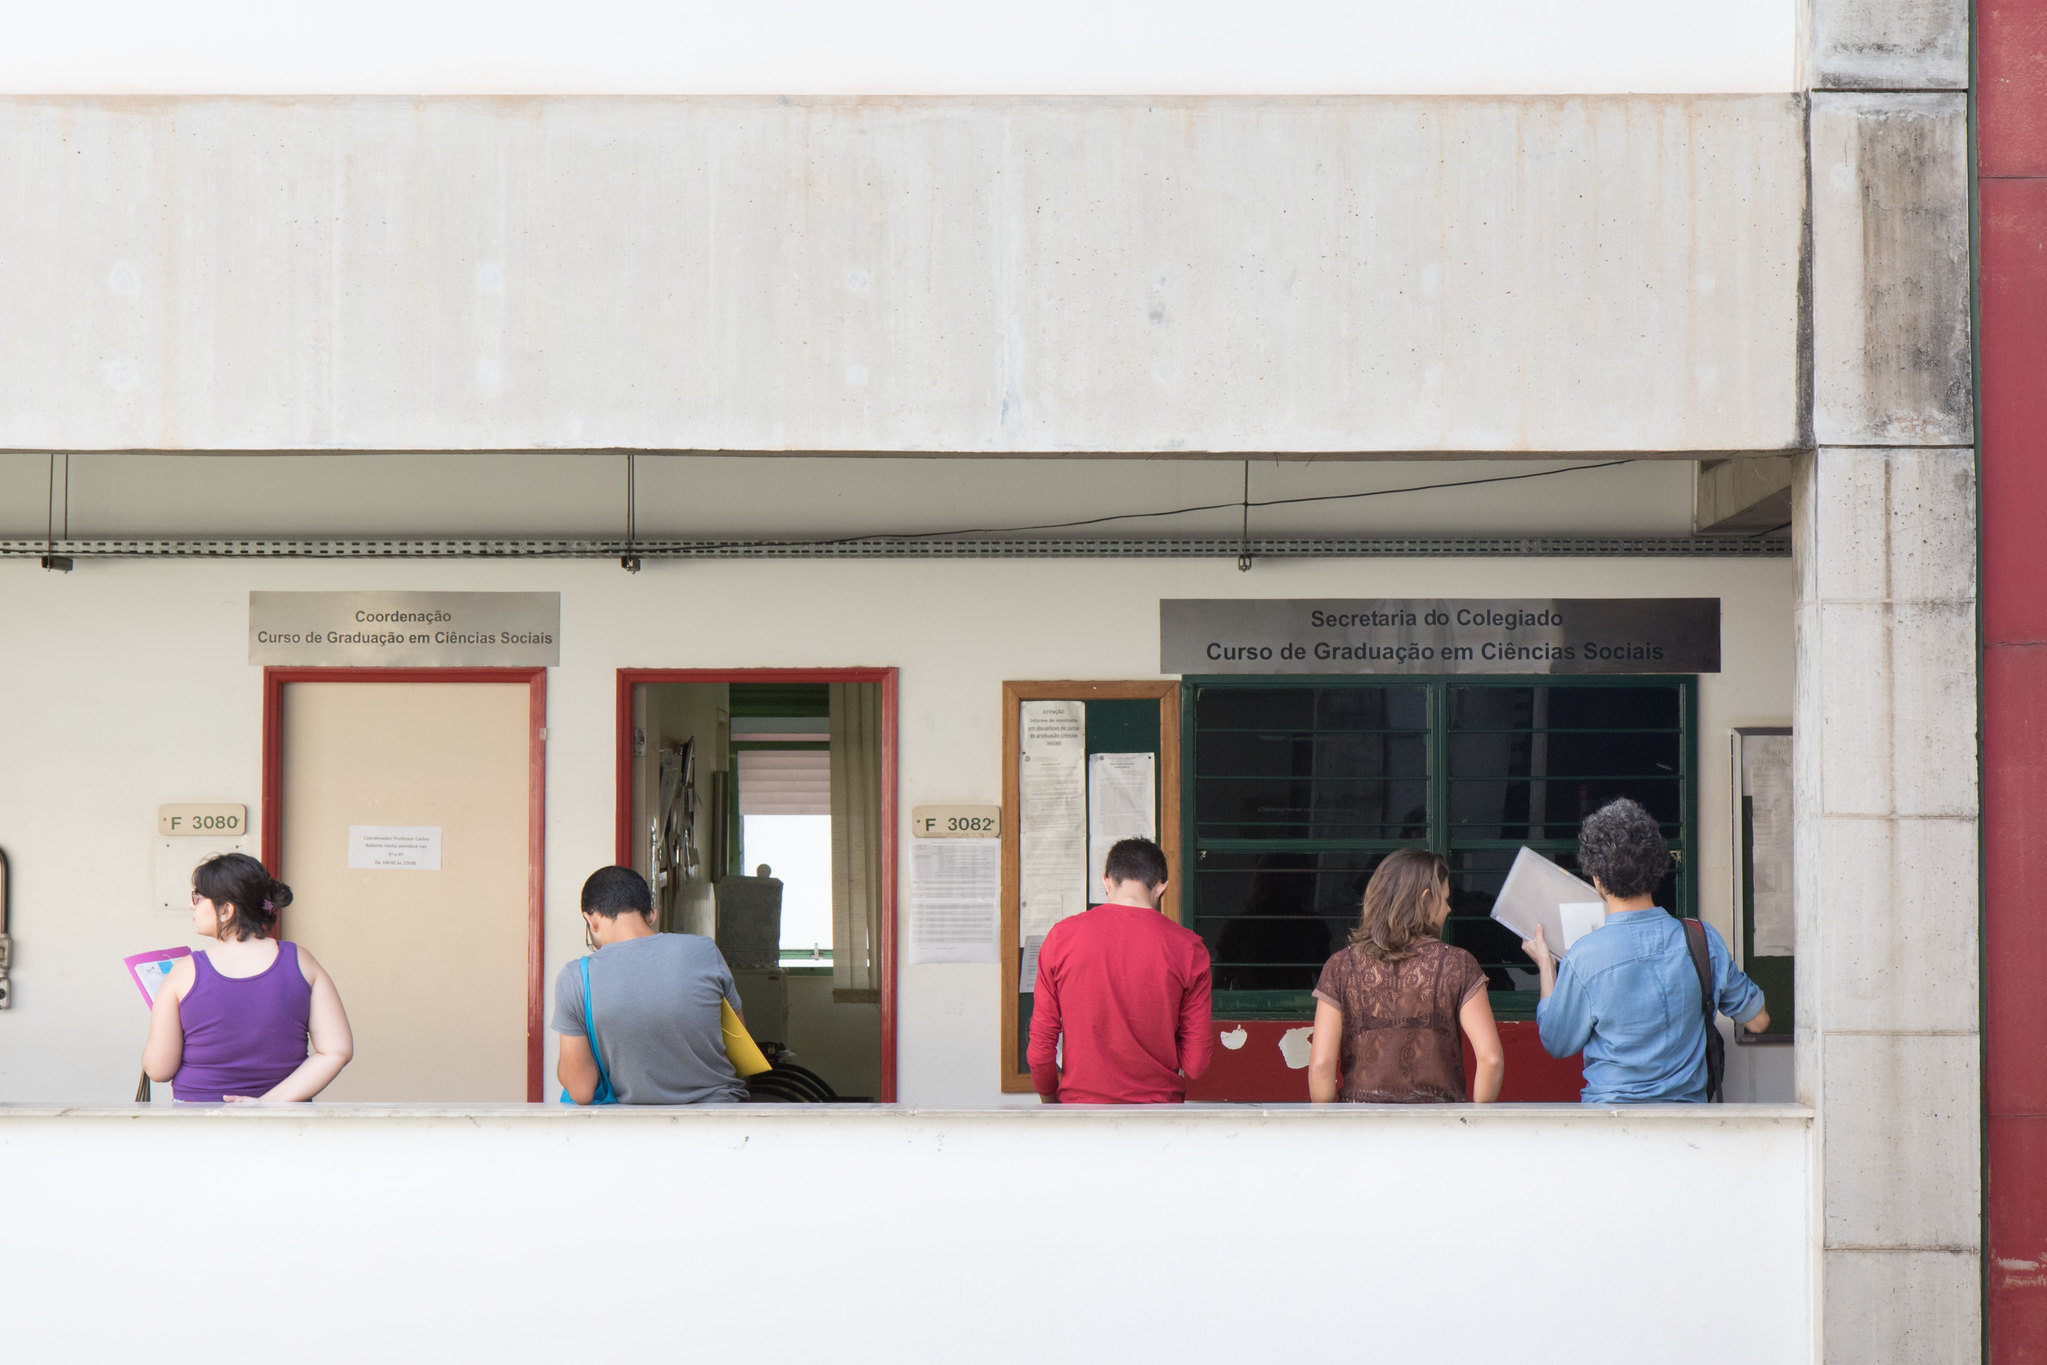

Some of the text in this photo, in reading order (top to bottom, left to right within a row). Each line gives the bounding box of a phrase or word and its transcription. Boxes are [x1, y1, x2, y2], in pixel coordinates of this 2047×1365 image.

[355, 610, 451, 625] Coordenação
[1311, 609, 1563, 630] Secretaria do Colegiado
[257, 631, 553, 647] Curso de Graduação em Ciências Sociais
[1206, 641, 1664, 664] Curso de Graduação em Ciências Sociais
[171, 815, 238, 830] F 3080
[925, 817, 992, 831] F 3082
